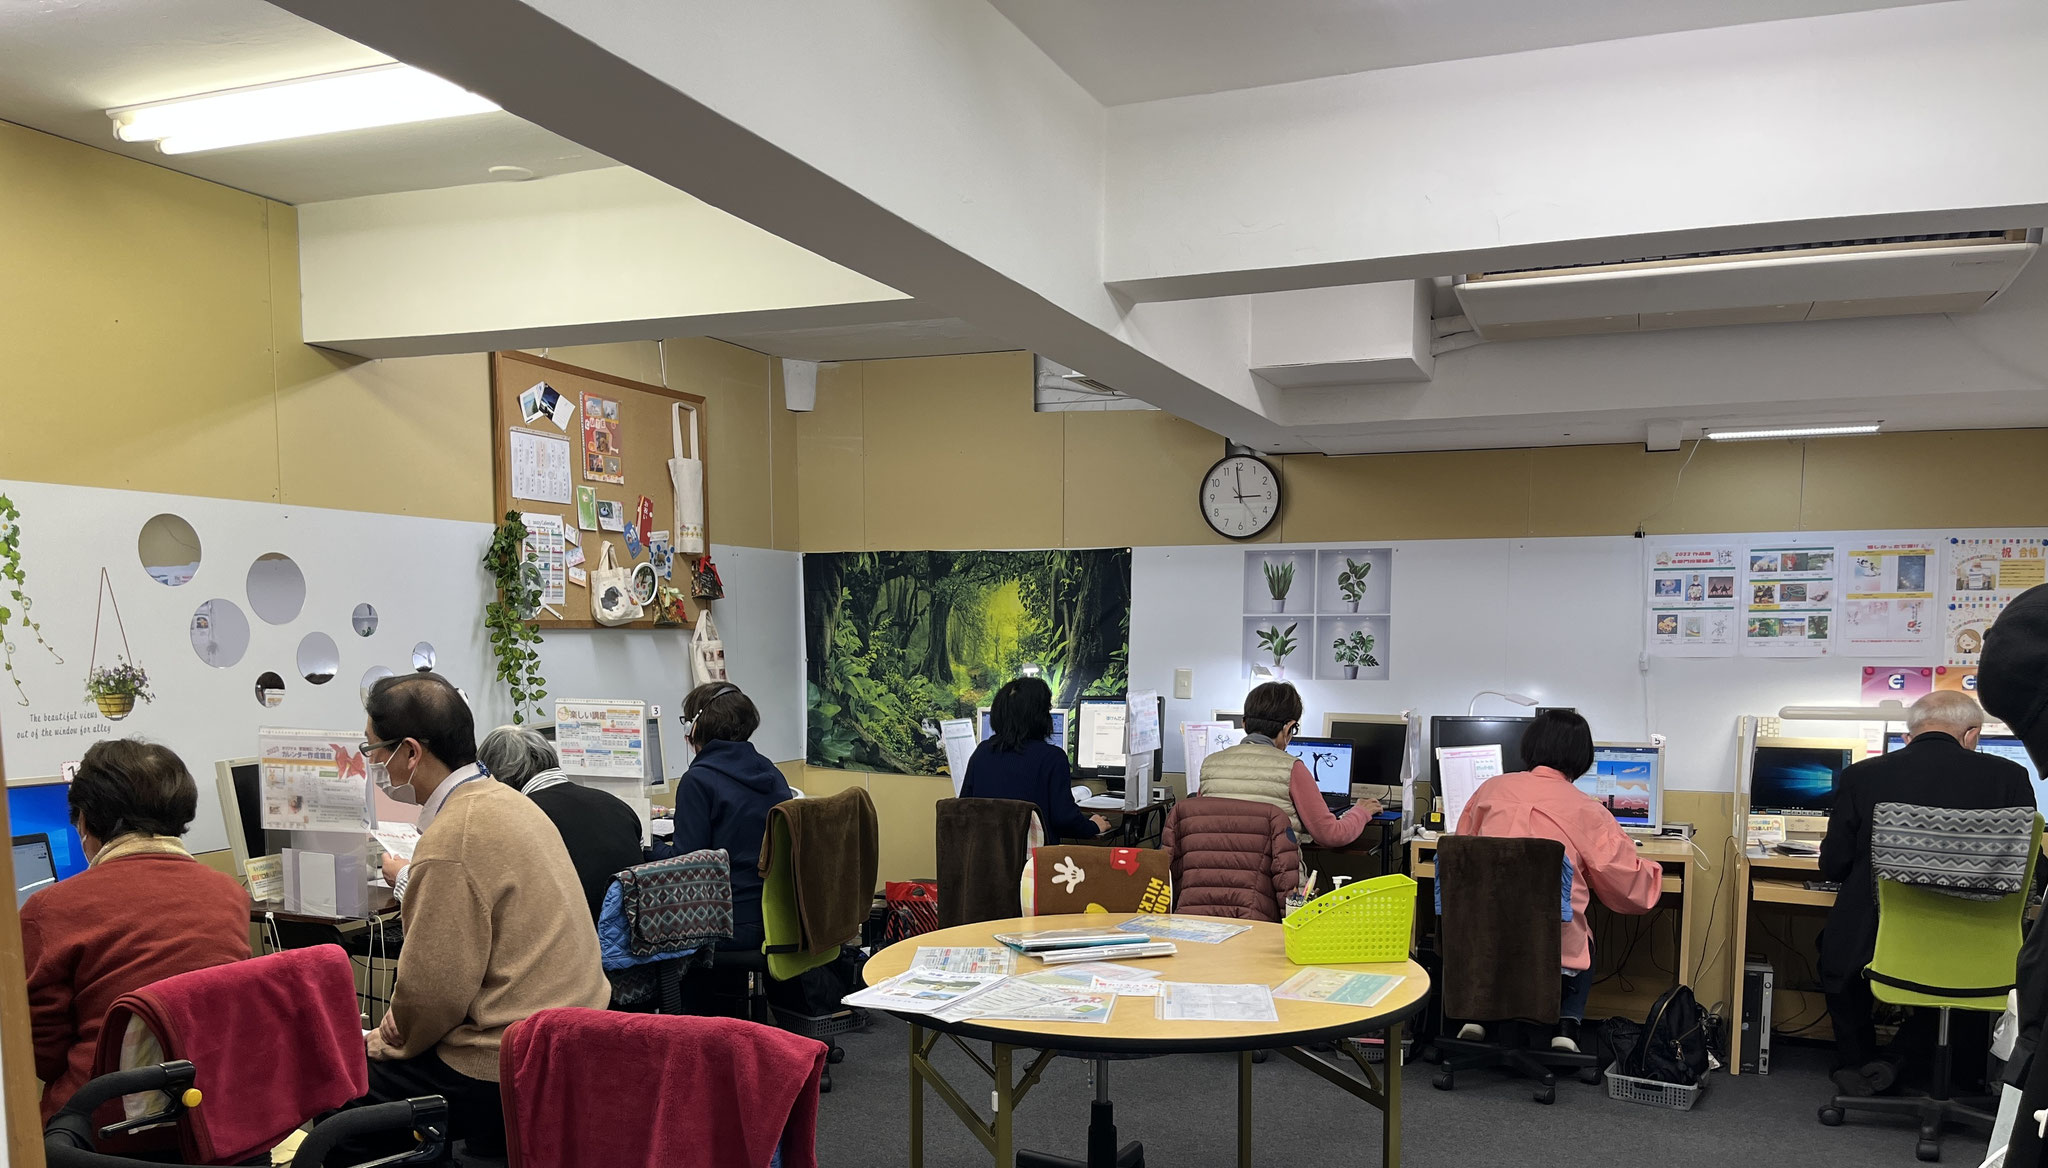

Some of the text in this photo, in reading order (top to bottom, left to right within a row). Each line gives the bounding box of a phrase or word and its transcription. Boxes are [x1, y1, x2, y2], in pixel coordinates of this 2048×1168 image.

[1235, 462, 1244, 471] 12
[1252, 466, 1256, 475] 1
[1223, 467, 1230, 476] 11
[1211, 478, 1220, 487] 10
[1262, 476, 1268, 485] 2
[1209, 494, 1215, 502] 9
[1266, 491, 1272, 500] 3
[1213, 508, 1219, 517] 8
[1262, 506, 1268, 514] 4
[1224, 518, 1229, 527] 7
[1238, 522, 1243, 530] 6
[1252, 517, 1257, 526] 5
[2001, 547, 2012, 558] 祝
[570, 710, 607, 720] 楽しい講座
[653, 707, 659, 715] 3
[30, 711, 98, 722] The beautiful views
[16, 724, 111, 739] out of the window for alley
[1137, 877, 1163, 914] MICK
